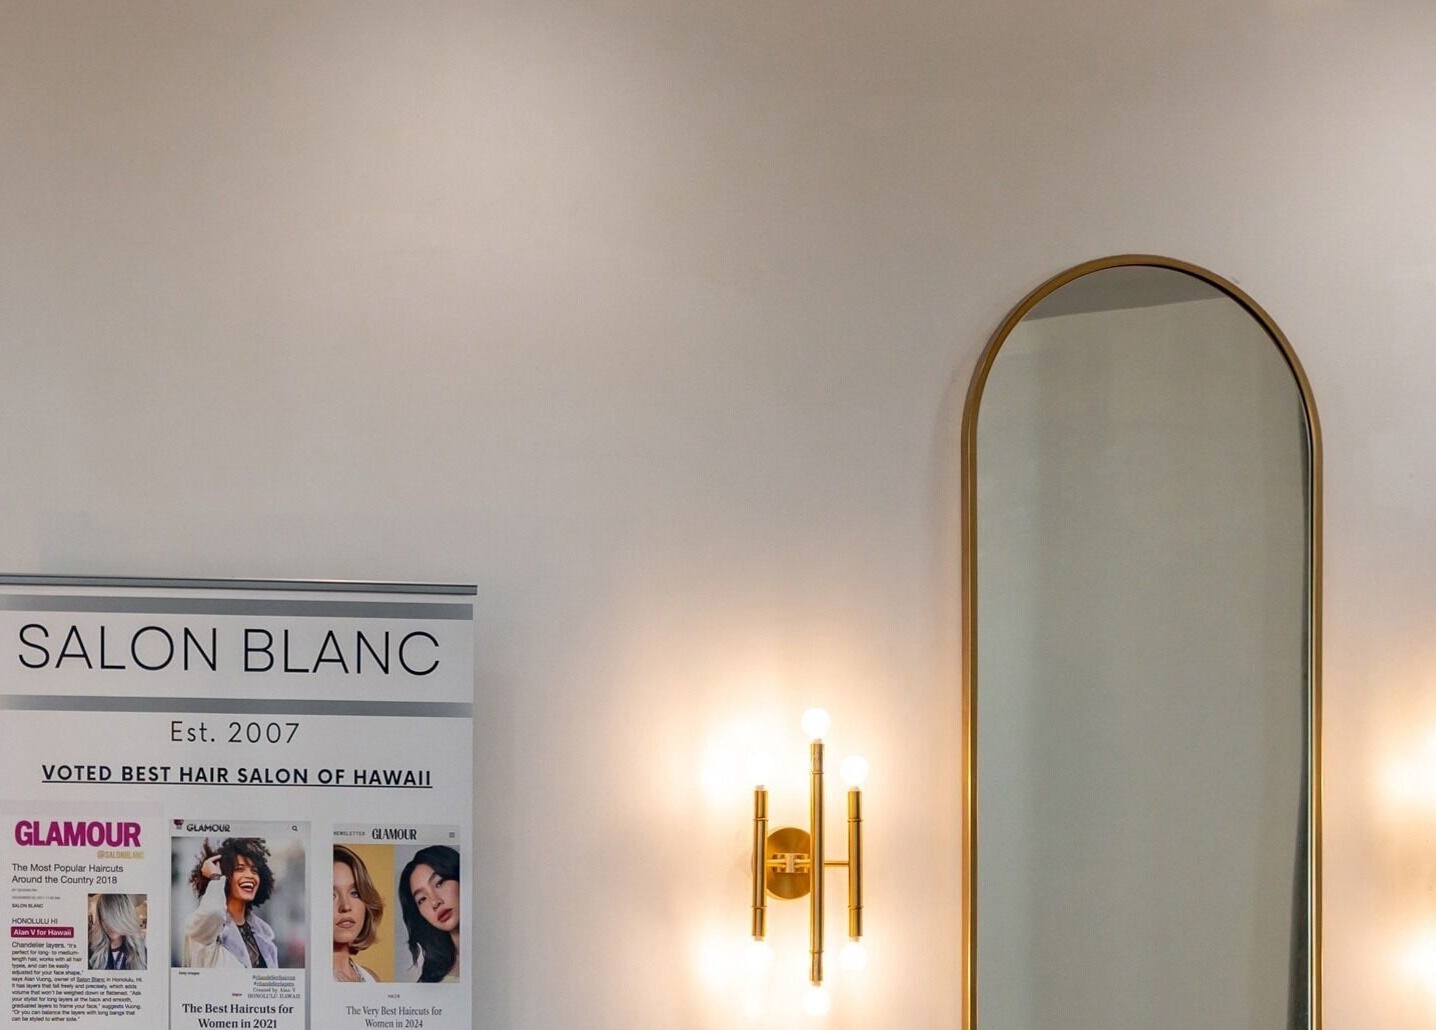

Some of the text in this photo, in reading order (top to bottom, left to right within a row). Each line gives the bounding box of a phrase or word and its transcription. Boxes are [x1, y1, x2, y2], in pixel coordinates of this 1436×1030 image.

[19, 624, 440, 675] SALON BLANC
[171, 721, 299, 744] Est. 2007
[42, 765, 431, 785] VOTED BEST HAIR SALON OF HAWAII
[187, 824, 230, 832] GLAMOUR
[15, 821, 141, 847] GLAMOUR
[372, 829, 416, 840] GLAMOUR
[54, 864, 85, 873] Popular
[61, 876, 93, 885] Country
[182, 1004, 293, 1013] The Best Haircuts for
[346, 1006, 442, 1017] The Very Best Haircuts for
[198, 1019, 276, 1028] Women in 2021
[366, 1019, 423, 1028] Women in 2024
